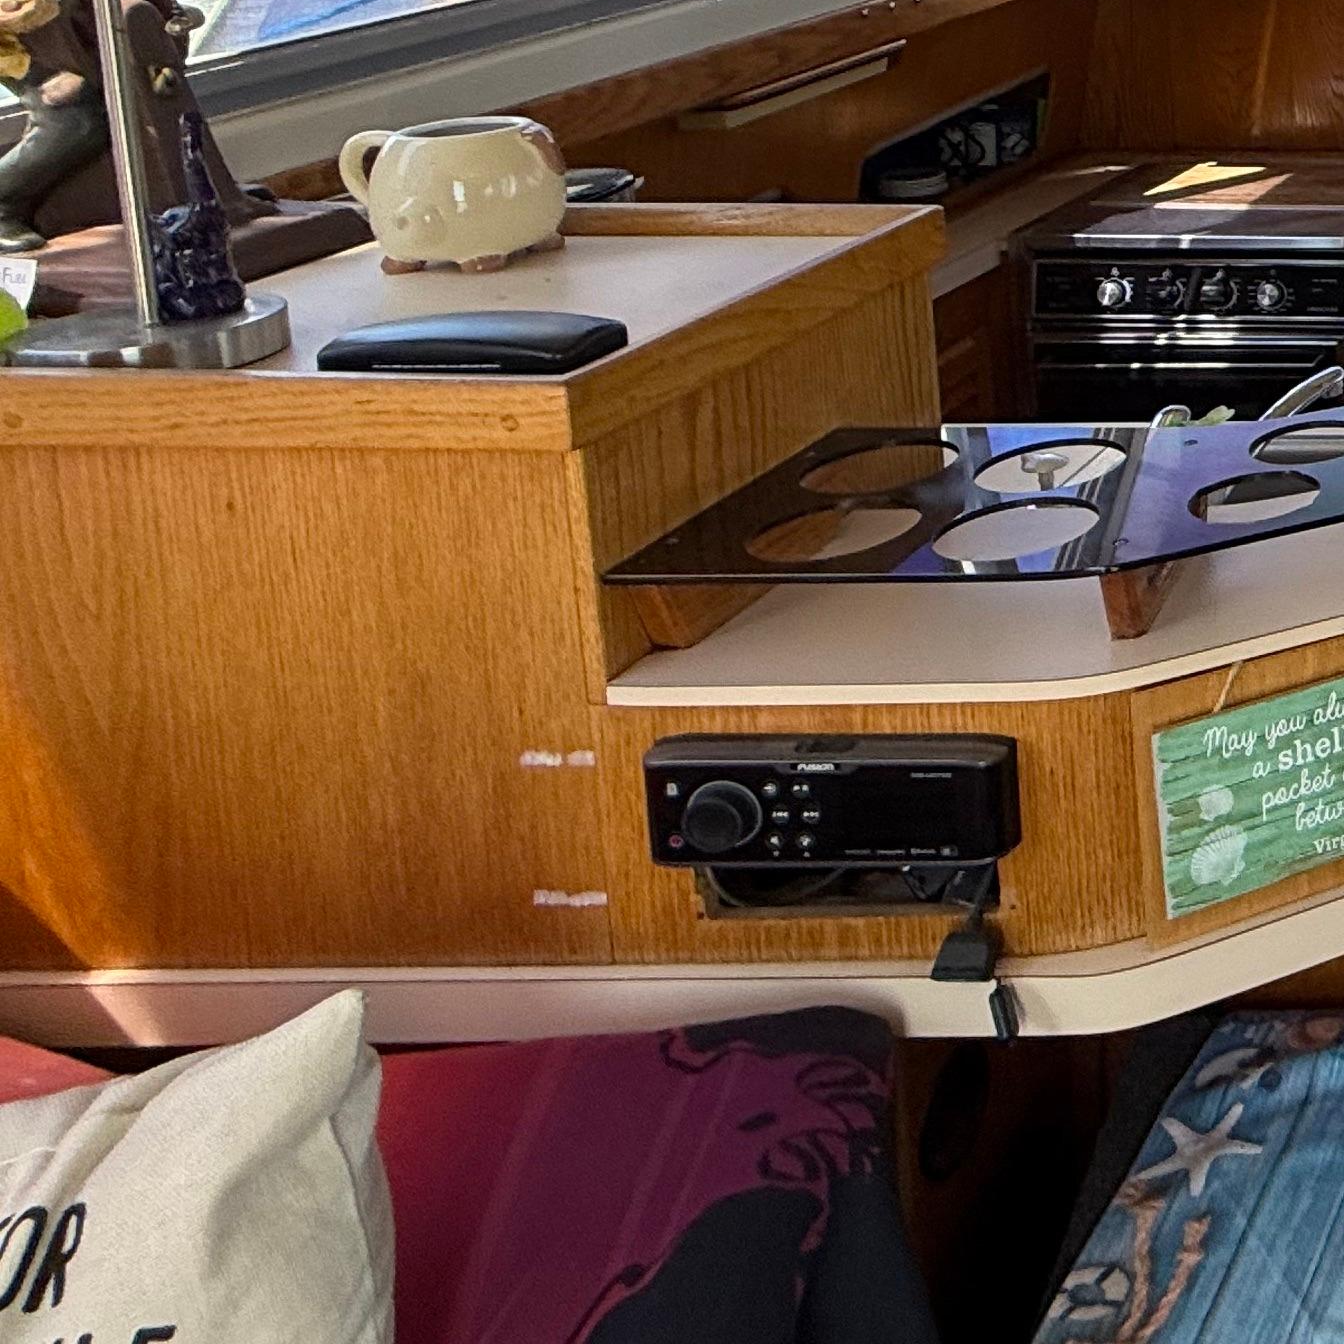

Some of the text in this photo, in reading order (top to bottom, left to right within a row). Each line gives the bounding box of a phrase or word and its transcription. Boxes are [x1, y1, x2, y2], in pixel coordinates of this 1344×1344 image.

[1203, 726, 1257, 758] May
[1265, 715, 1306, 749] you
[1252, 761, 1270, 778] a
[1262, 763, 1335, 821] pocket
[0, 1201, 87, 1314] OR
